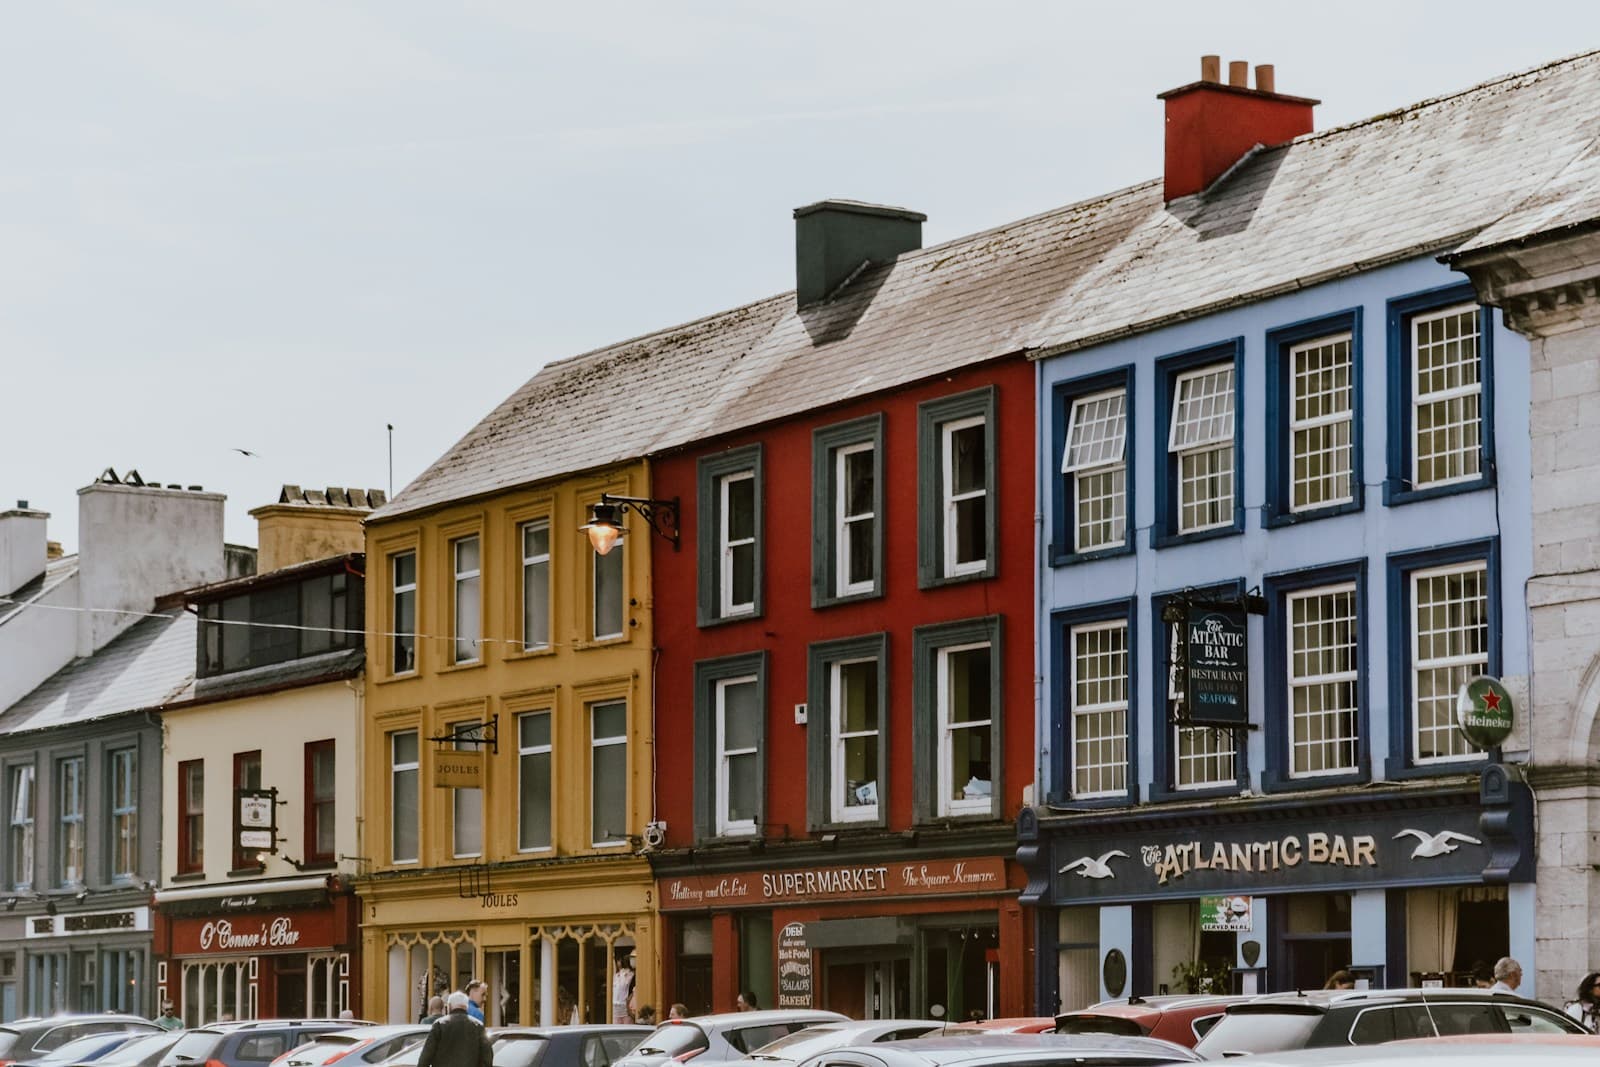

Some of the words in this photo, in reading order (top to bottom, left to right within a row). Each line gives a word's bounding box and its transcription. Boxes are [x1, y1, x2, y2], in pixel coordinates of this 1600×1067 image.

[1205, 619, 1224, 633] The
[1190, 626, 1243, 647] ATLANTIC
[1205, 645, 1229, 659] BAR
[1191, 669, 1243, 681] RESTAURANT
[1467, 715, 1511, 728] Heineken
[438, 764, 480, 775] JOULES
[1141, 845, 1161, 867] The
[1154, 836, 1301, 885] ATLANTIC
[1307, 832, 1377, 867] BAR
[762, 867, 887, 897] SUPERMARKET
[902, 866, 918, 886] The
[481, 894, 518, 908] JOULES
[646, 890, 652, 903] 3
[200, 921, 268, 950] O'Connor's
[270, 917, 300, 946] Bar
[785, 926, 803, 937] DELI
[779, 949, 791, 960] Hot
[792, 948, 810, 959] Food
[779, 994, 811, 1006] BAKERY
